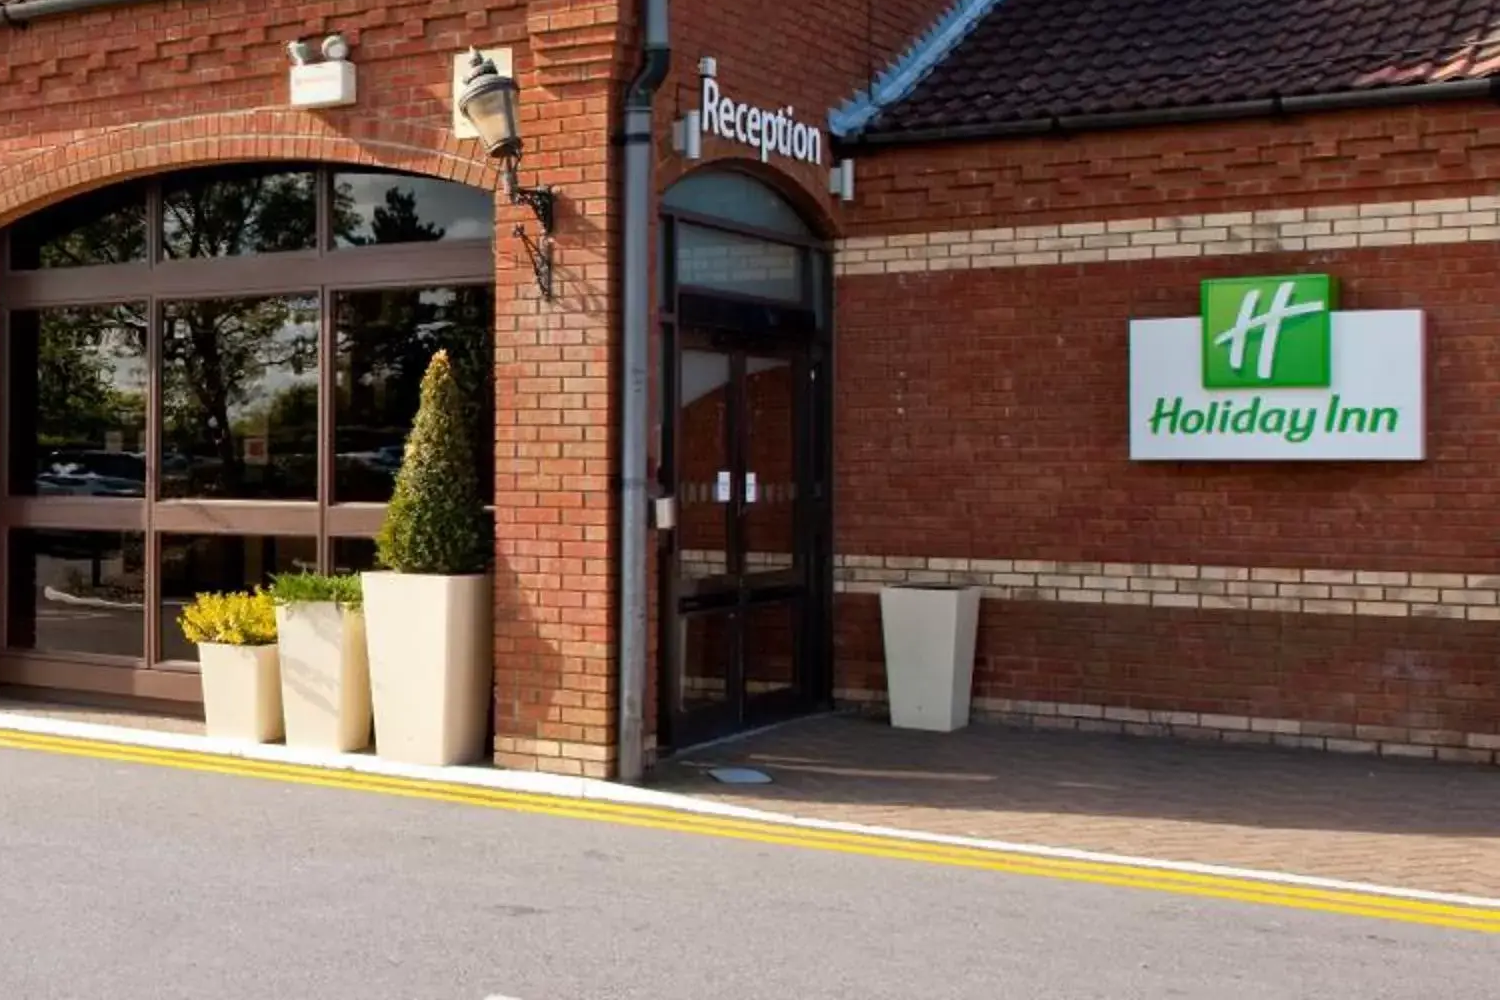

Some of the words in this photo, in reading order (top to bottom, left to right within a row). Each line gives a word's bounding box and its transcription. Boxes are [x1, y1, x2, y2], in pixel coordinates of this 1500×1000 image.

[702, 77, 821, 165] Reception
[1148, 396, 1317, 443] Holiday
[1324, 394, 1399, 433] Inn
